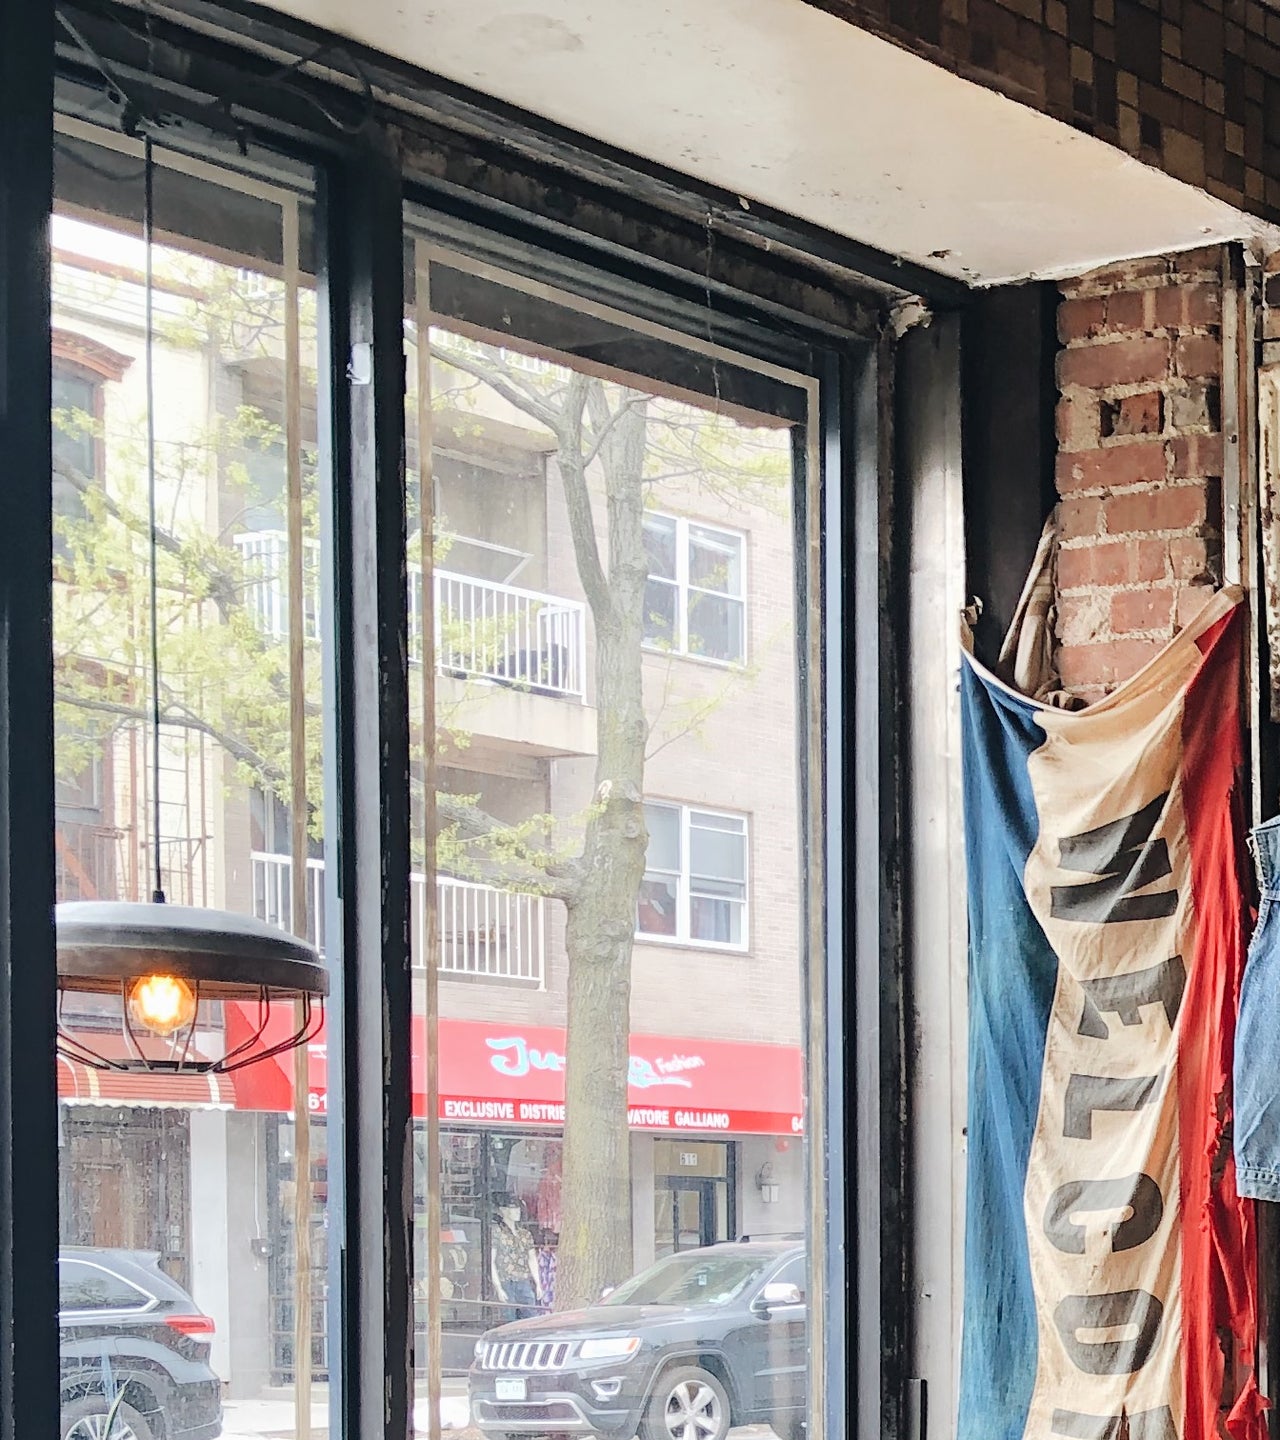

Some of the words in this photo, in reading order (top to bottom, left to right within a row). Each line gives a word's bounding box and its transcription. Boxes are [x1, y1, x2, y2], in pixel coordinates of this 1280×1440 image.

[445, 1100, 514, 1120] EXCLUSIVE
[520, 1103, 566, 1121] DISTRI
[627, 1110, 669, 1127] VATORE
[675, 1111, 730, 1129] GALLIANO
